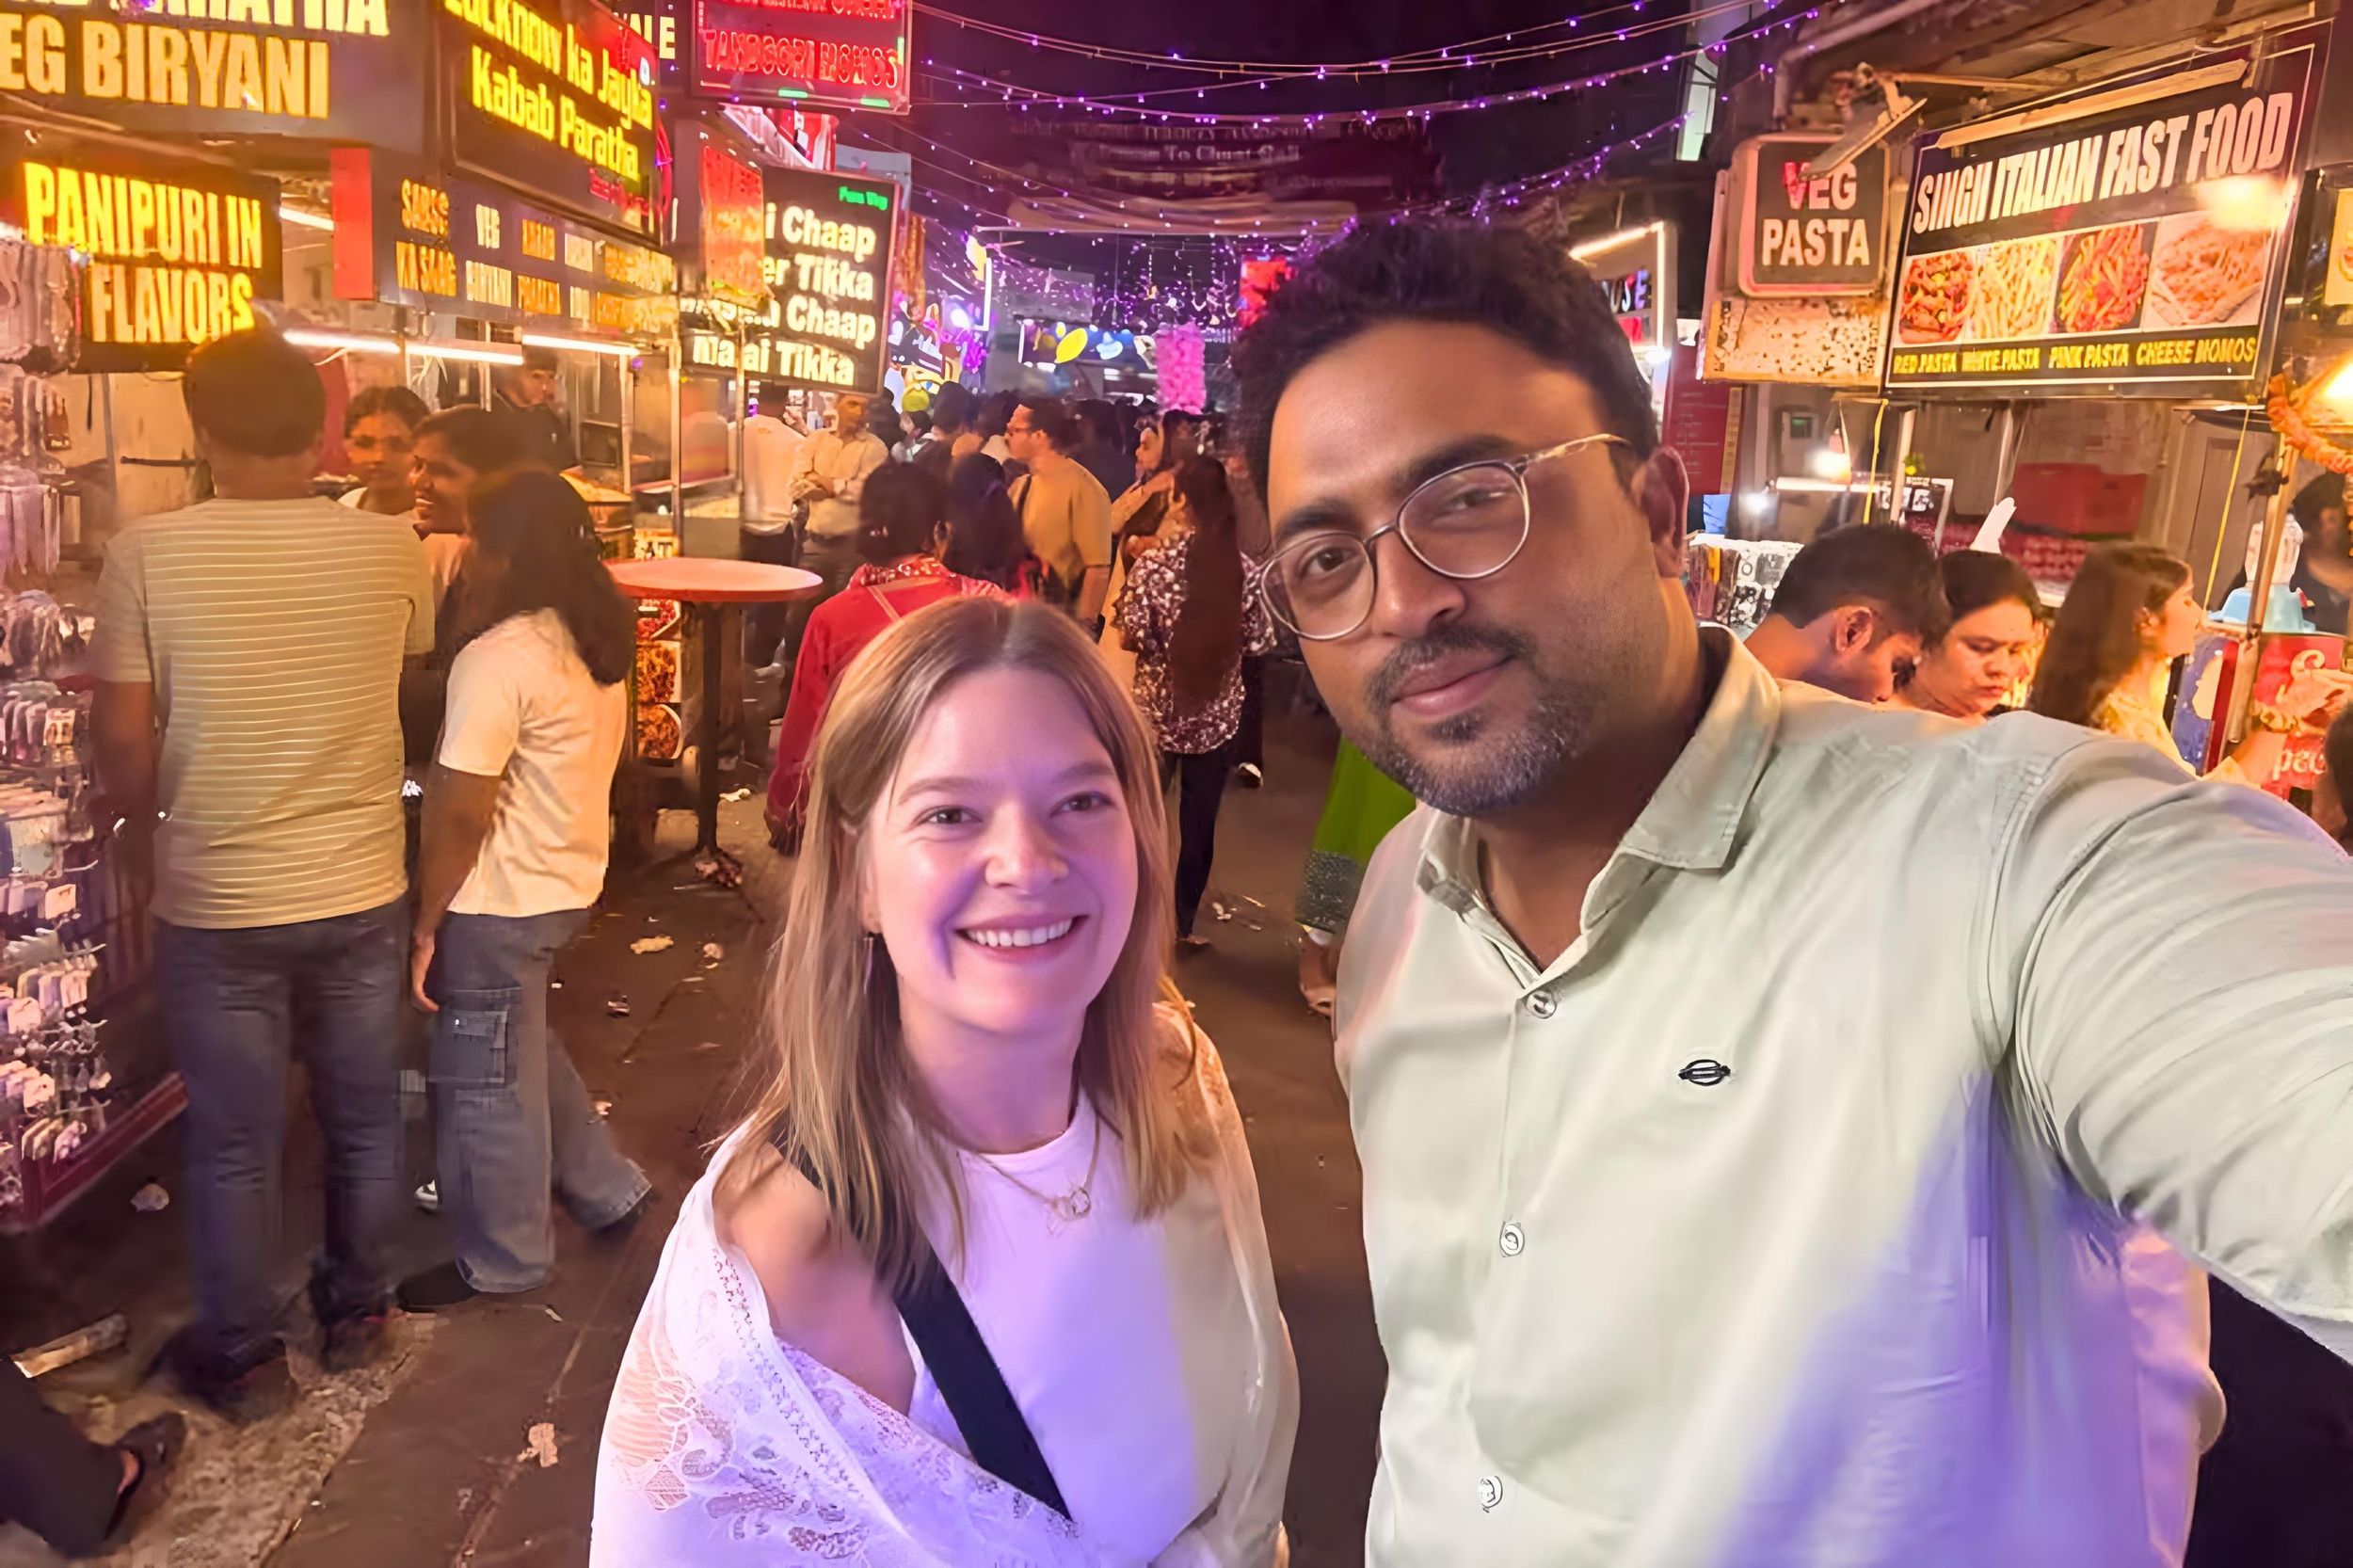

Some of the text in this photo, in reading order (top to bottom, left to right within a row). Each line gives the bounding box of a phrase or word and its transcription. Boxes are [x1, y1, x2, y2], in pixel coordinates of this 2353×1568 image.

[82, 20, 329, 120] BIRYANI
[567, 23, 594, 95] ka
[598, 48, 652, 131] Jayka
[472, 44, 641, 183] Kabab Paratha
[1784, 160, 1858, 210] VEG
[1913, 92, 2294, 233] SINGH ITALIAN FAST FOOD
[24, 161, 263, 269] PANIPURI IN
[782, 205, 876, 263] Chaap
[1761, 218, 1870, 266] PASTA
[92, 263, 255, 345] FLAVORS
[794, 252, 873, 300] Tikka
[786, 294, 876, 350] Chaap
[776, 340, 855, 386] Tikka
[1894, 355, 1918, 374] RED
[2000, 347, 2041, 370] PASTA
[2048, 345, 2084, 368] PINK
[2083, 344, 2130, 368] PASTA
[2136, 340, 2196, 365] CHEESE
[2194, 337, 2256, 363] MOMOS
